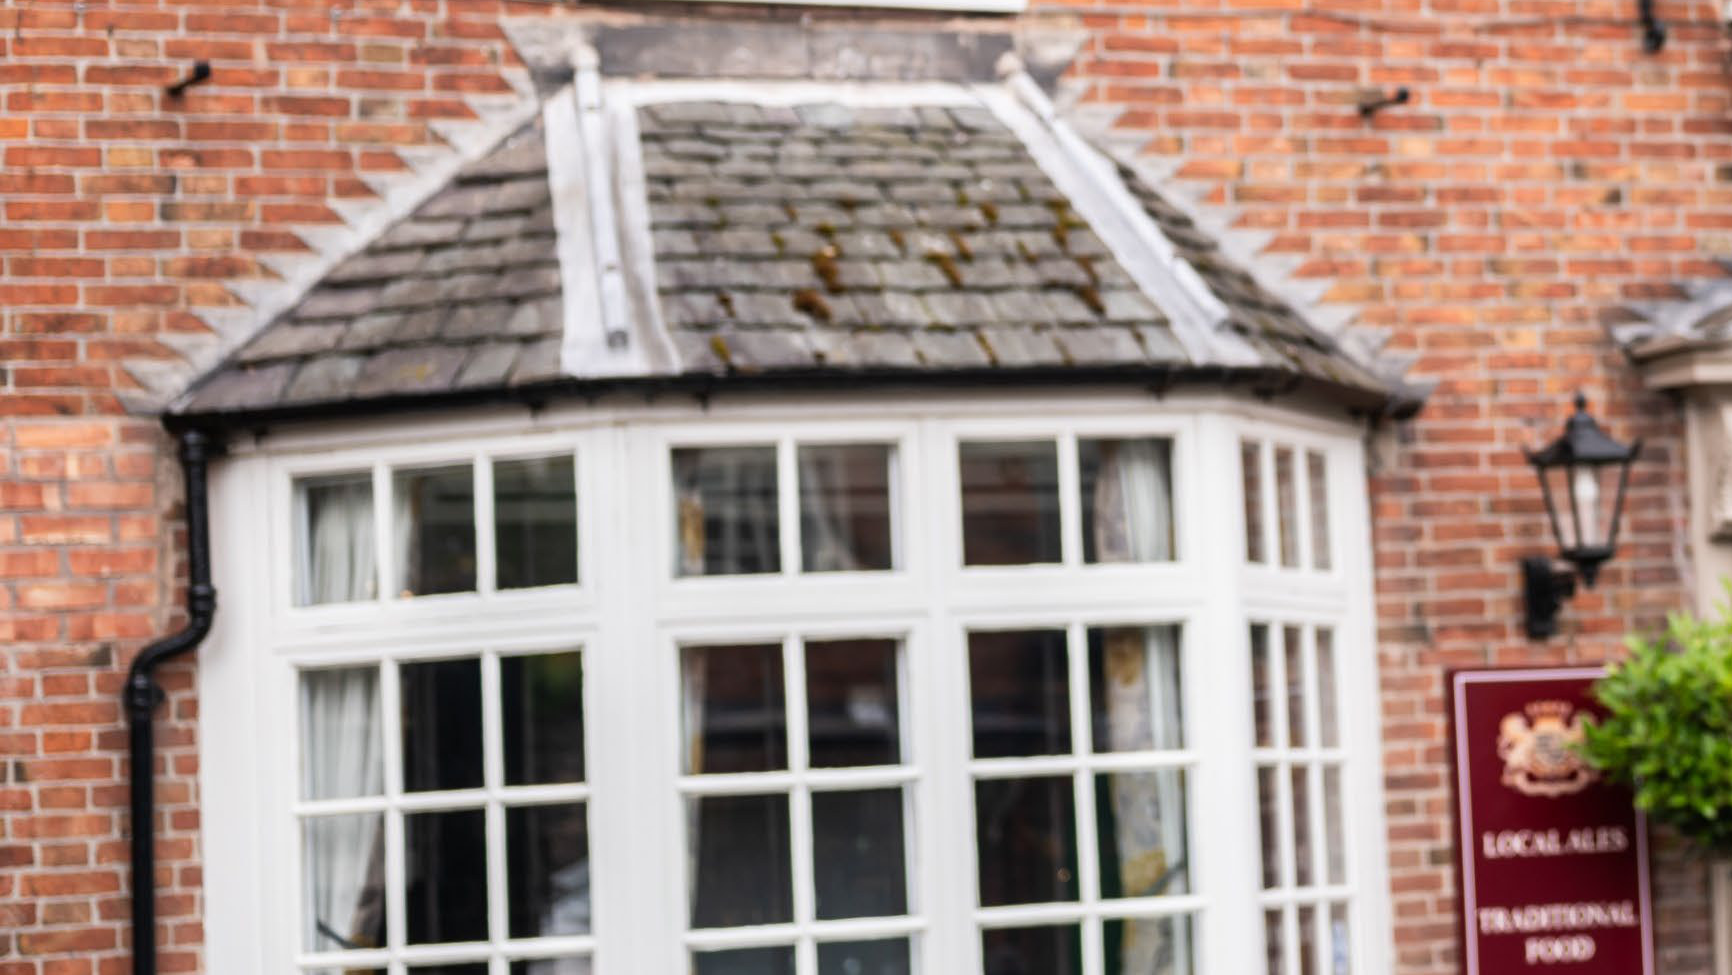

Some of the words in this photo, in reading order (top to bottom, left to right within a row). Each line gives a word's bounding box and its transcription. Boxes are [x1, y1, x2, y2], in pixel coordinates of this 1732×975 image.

[1482, 829, 1561, 858] LOCAL
[1565, 826, 1628, 853] ALES
[1478, 901, 1636, 935] TRADITIONAL
[1525, 935, 1596, 964] FOOD
